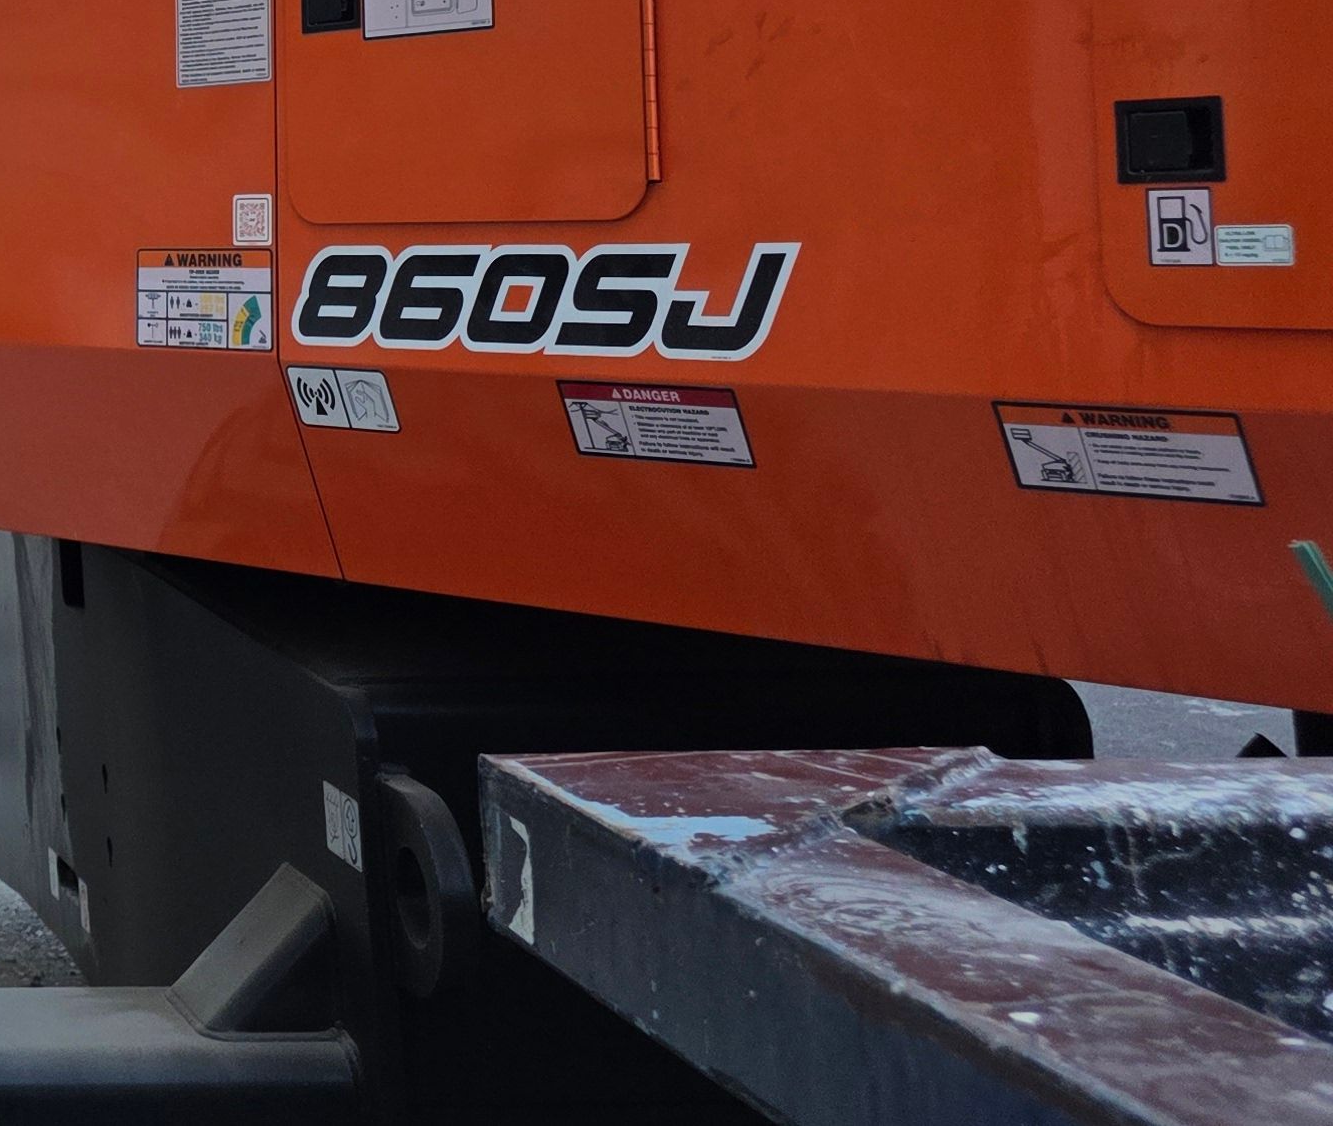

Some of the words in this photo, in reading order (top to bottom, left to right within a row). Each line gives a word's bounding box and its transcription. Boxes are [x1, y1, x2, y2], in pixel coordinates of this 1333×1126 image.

[177, 253, 243, 267] WARNING
[295, 248, 795, 355] 860SJ
[622, 388, 681, 403] DANGER
[1079, 412, 1170, 430] WARNING
